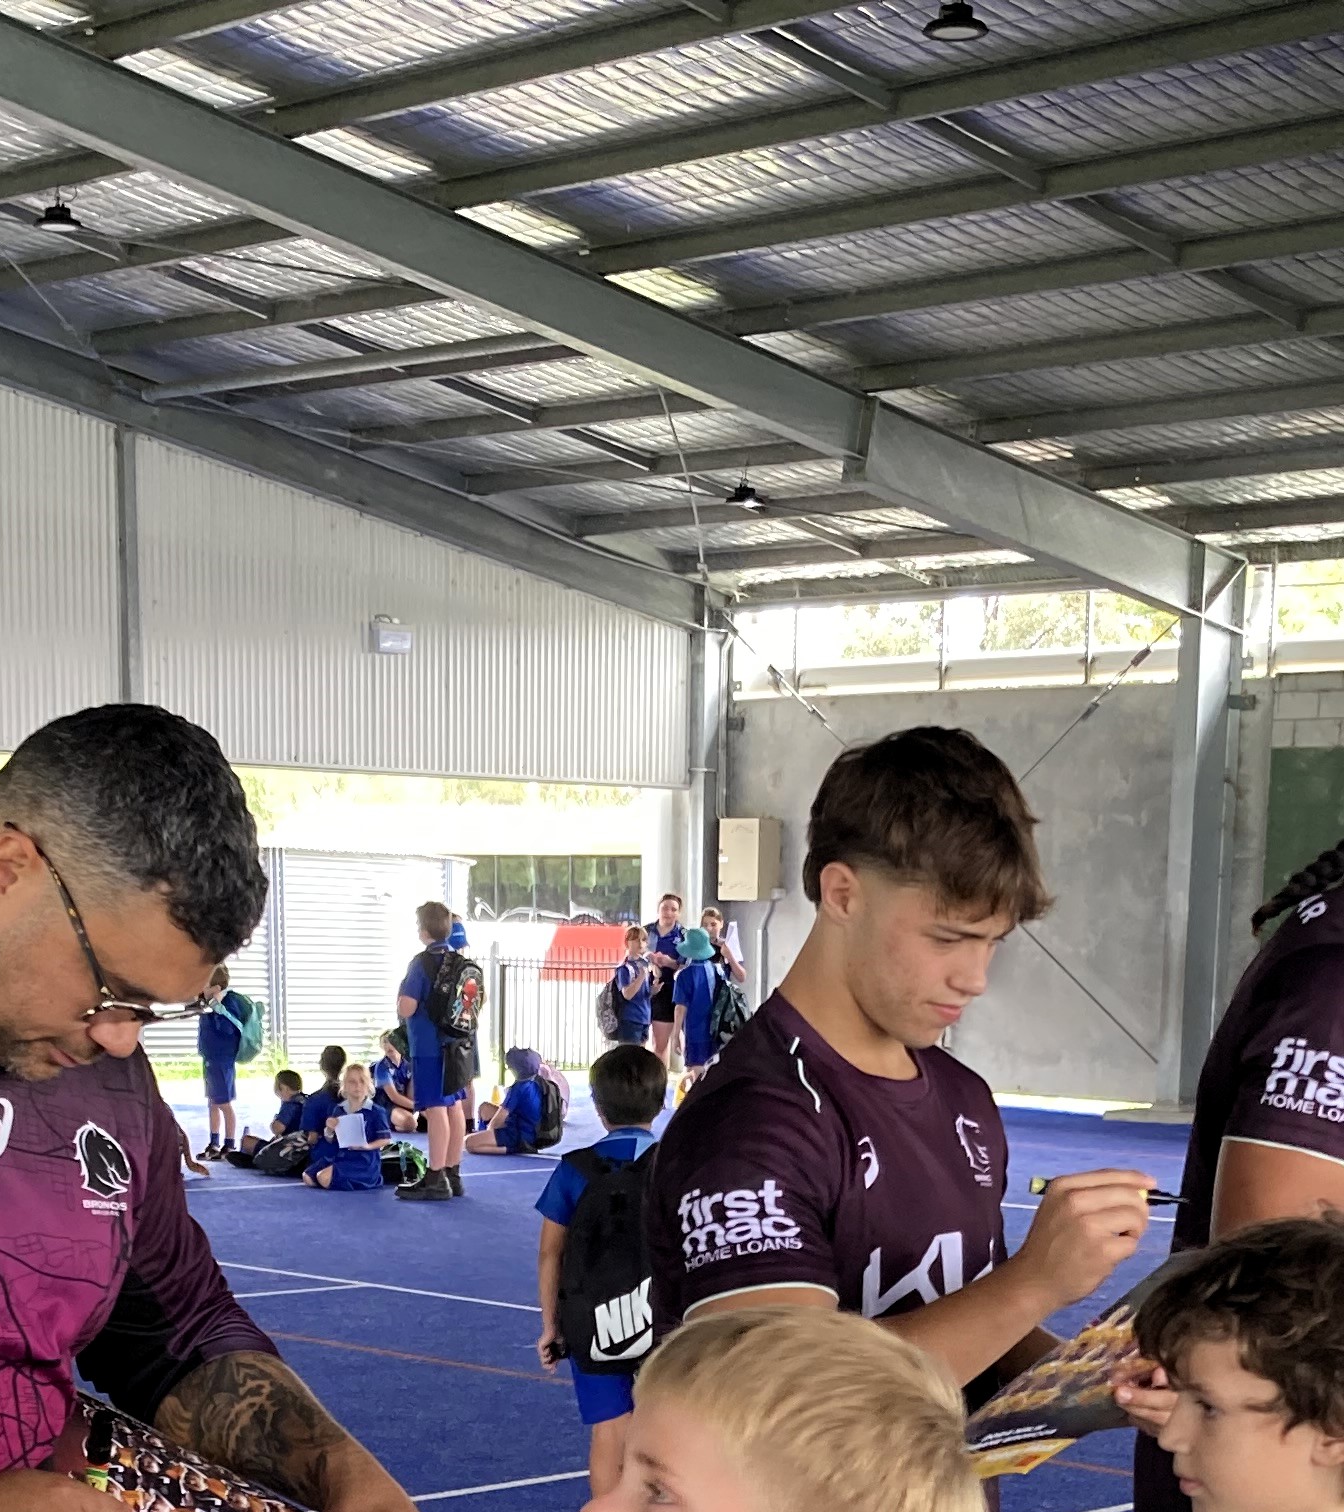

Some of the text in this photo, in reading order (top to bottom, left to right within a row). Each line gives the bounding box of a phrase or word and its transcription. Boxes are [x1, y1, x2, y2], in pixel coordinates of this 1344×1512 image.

[1260, 1092, 1314, 1116] HOME
[678, 1180, 784, 1235] first
[681, 1213, 802, 1255] mac
[684, 1236, 802, 1273] HOME LOANS
[594, 1276, 653, 1350] NIK
